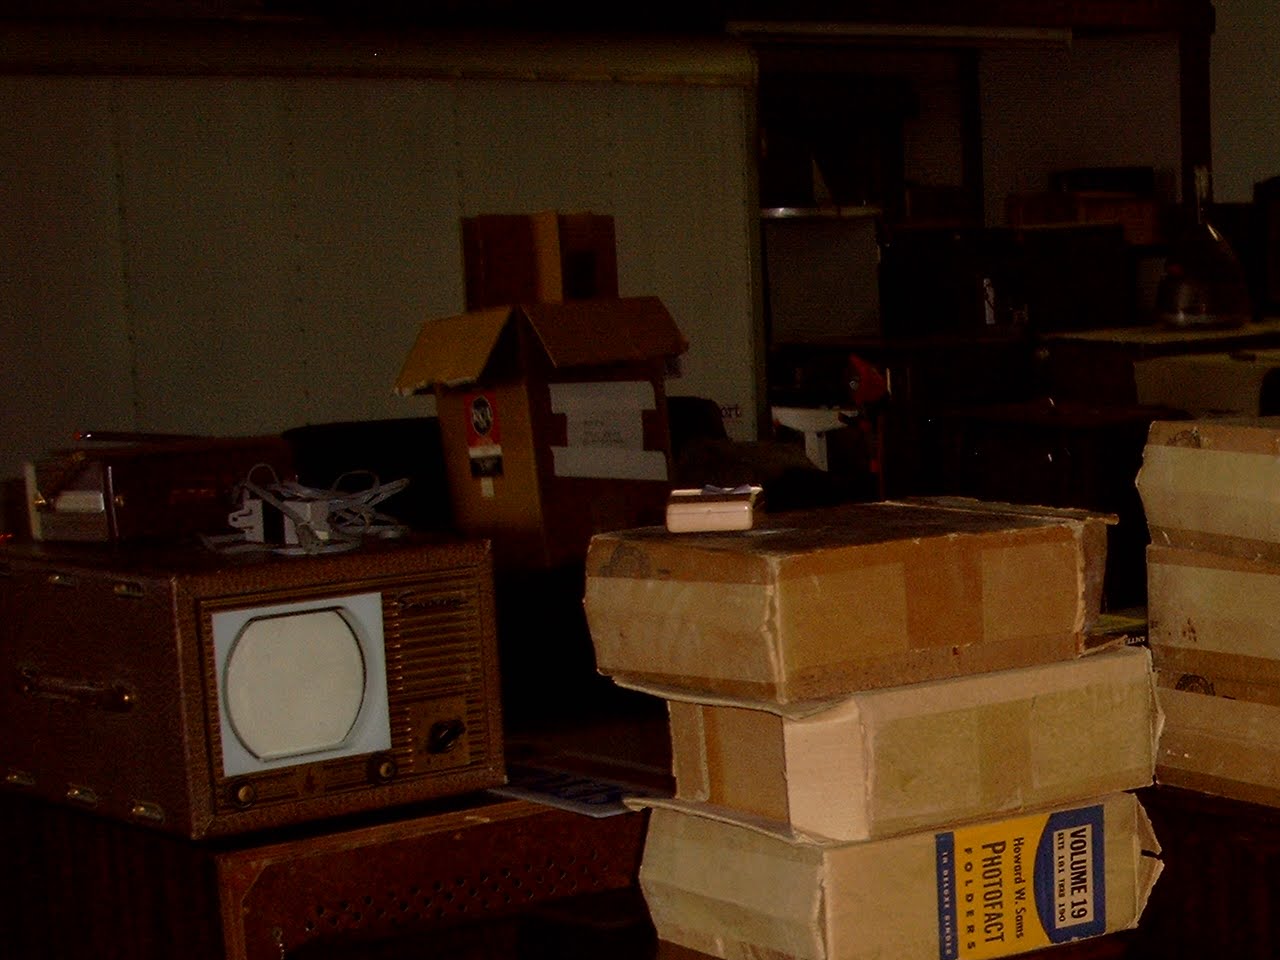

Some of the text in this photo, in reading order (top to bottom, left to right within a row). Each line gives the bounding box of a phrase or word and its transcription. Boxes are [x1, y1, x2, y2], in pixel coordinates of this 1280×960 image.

[964, 847, 976, 950] FOLDERS
[981, 840, 1006, 943] PHOTOFACT
[1013, 837, 1027, 939] Howard W. Sams
[1070, 827, 1088, 920] VOLUME 19
